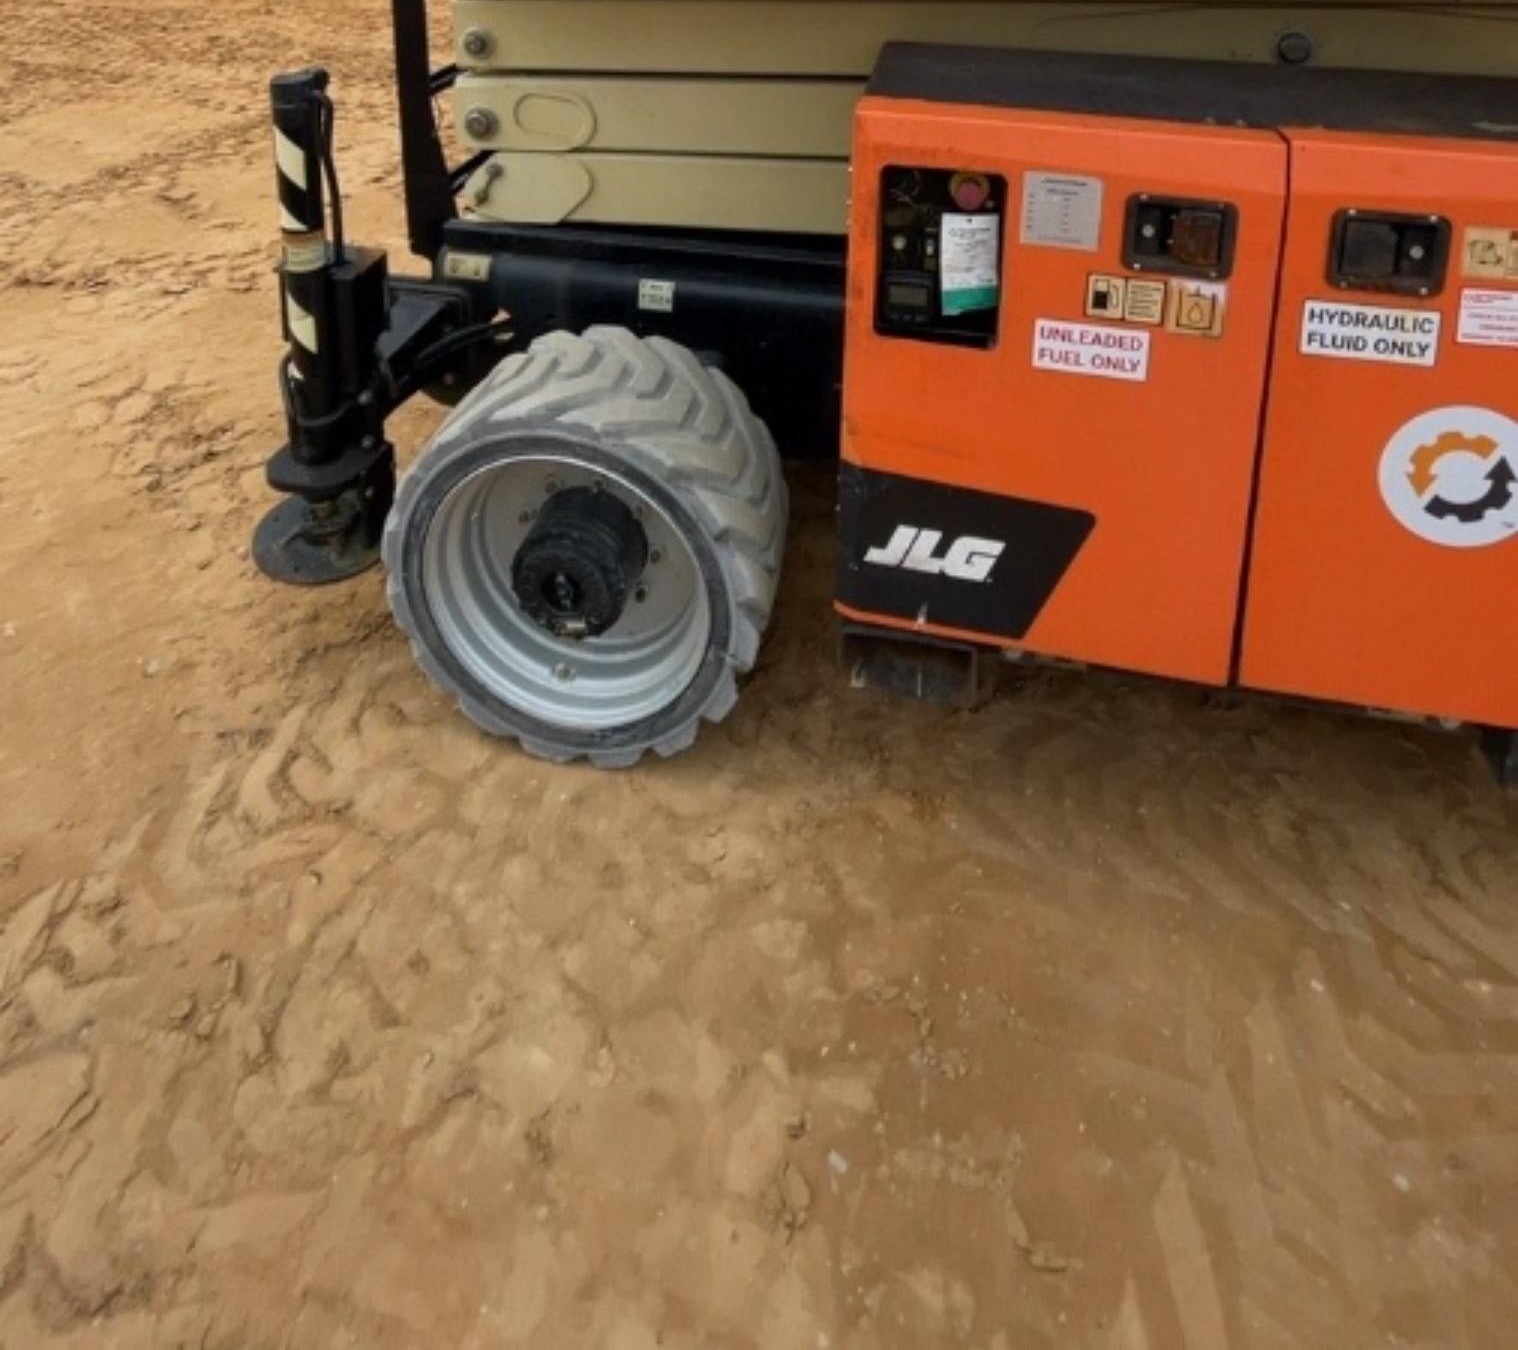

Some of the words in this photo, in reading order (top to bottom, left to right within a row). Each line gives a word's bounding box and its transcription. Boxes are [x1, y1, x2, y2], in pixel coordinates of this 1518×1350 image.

[1308, 308, 1434, 334] HYDRAULIC
[1039, 325, 1144, 352] UNLEADED
[1306, 331, 1368, 352] FLUID
[1373, 337, 1430, 358] ONLY
[1037, 347, 1084, 367] FUEL
[1090, 352, 1141, 373] ONLY
[863, 524, 1006, 582] JLG
